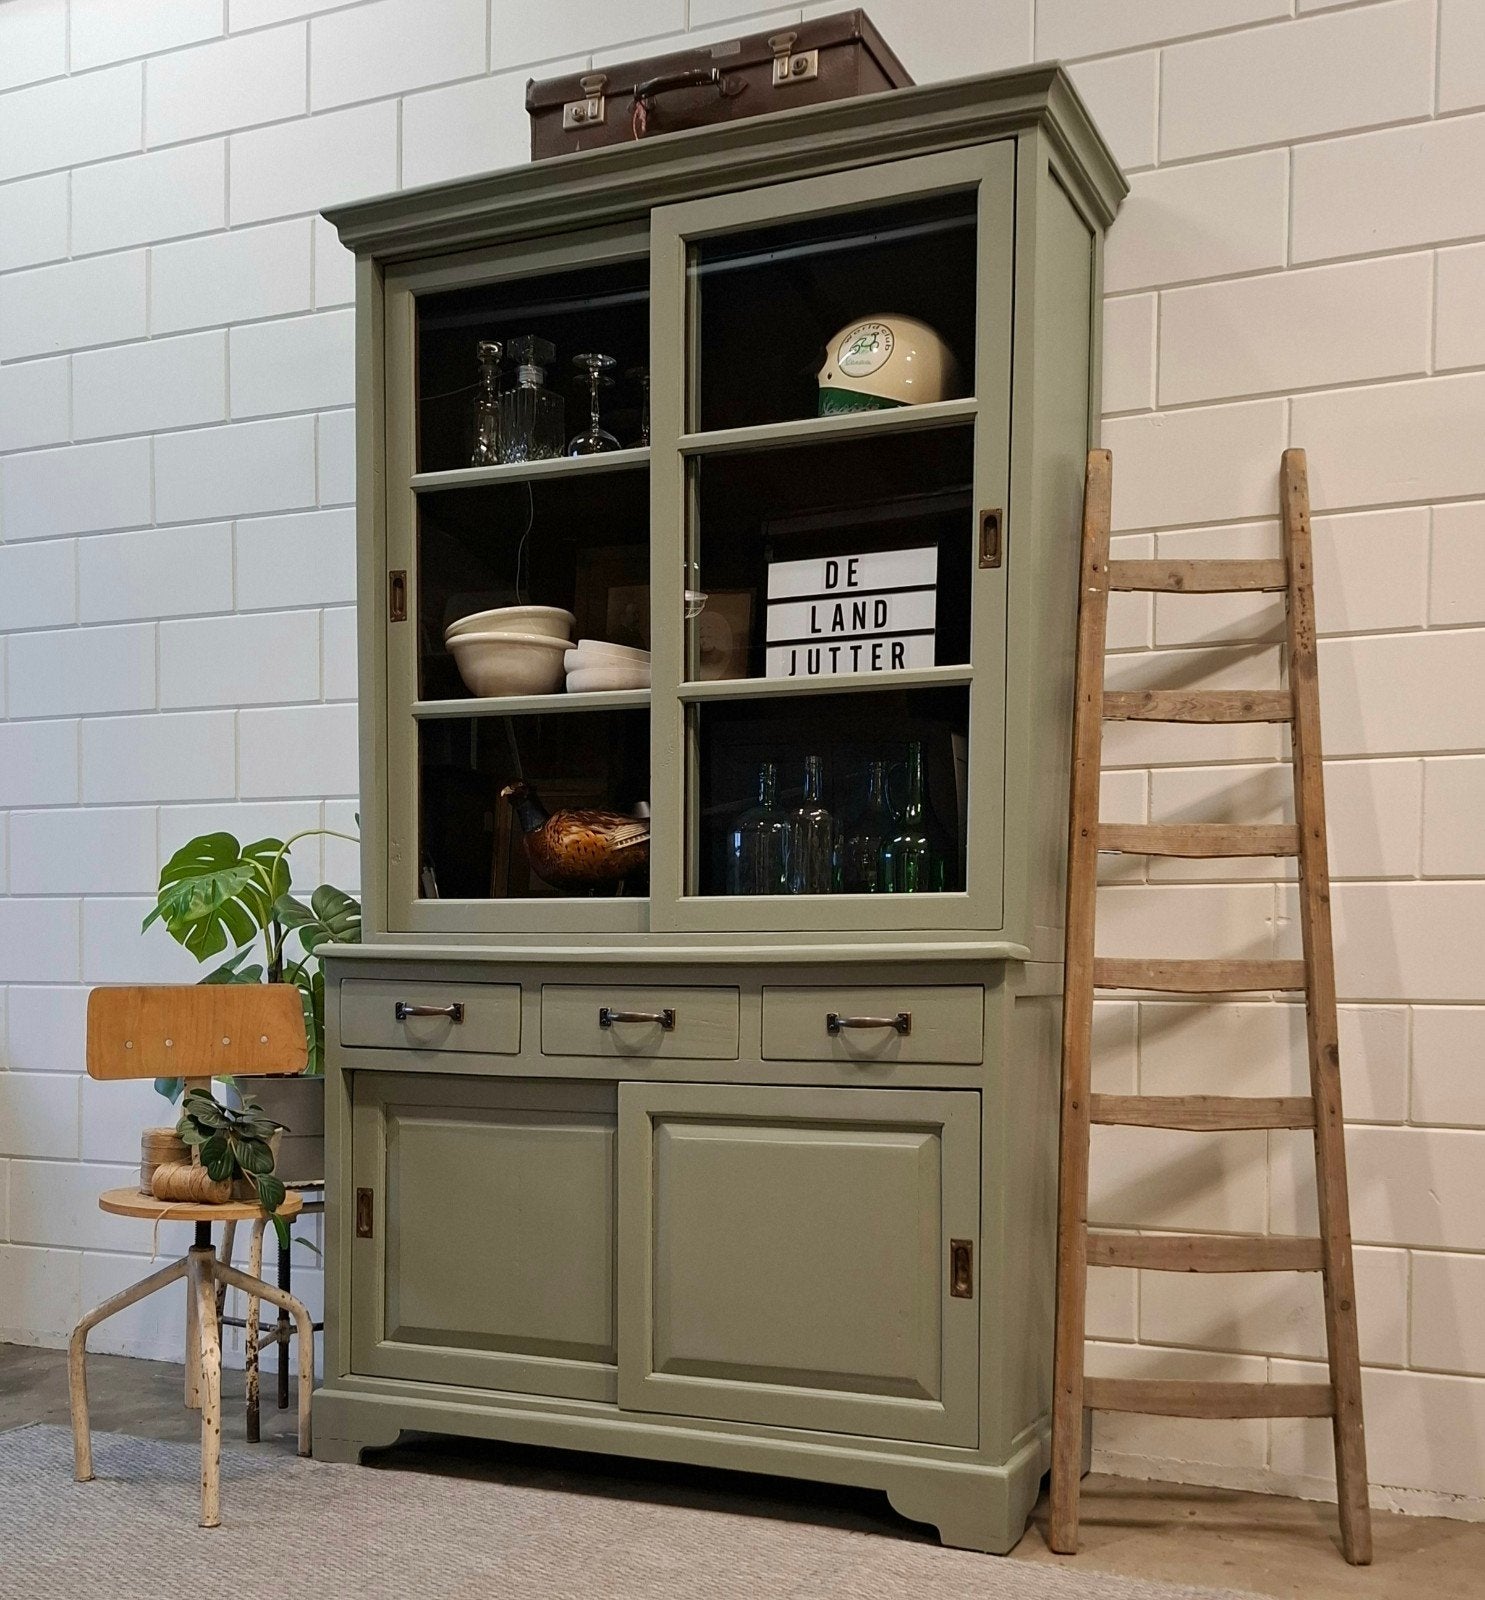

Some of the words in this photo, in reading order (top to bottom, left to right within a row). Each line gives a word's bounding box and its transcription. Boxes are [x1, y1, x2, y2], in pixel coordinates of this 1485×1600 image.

[825, 558, 859, 589] DE
[811, 600, 888, 634] LAND
[789, 642, 905, 676] JUTTER
